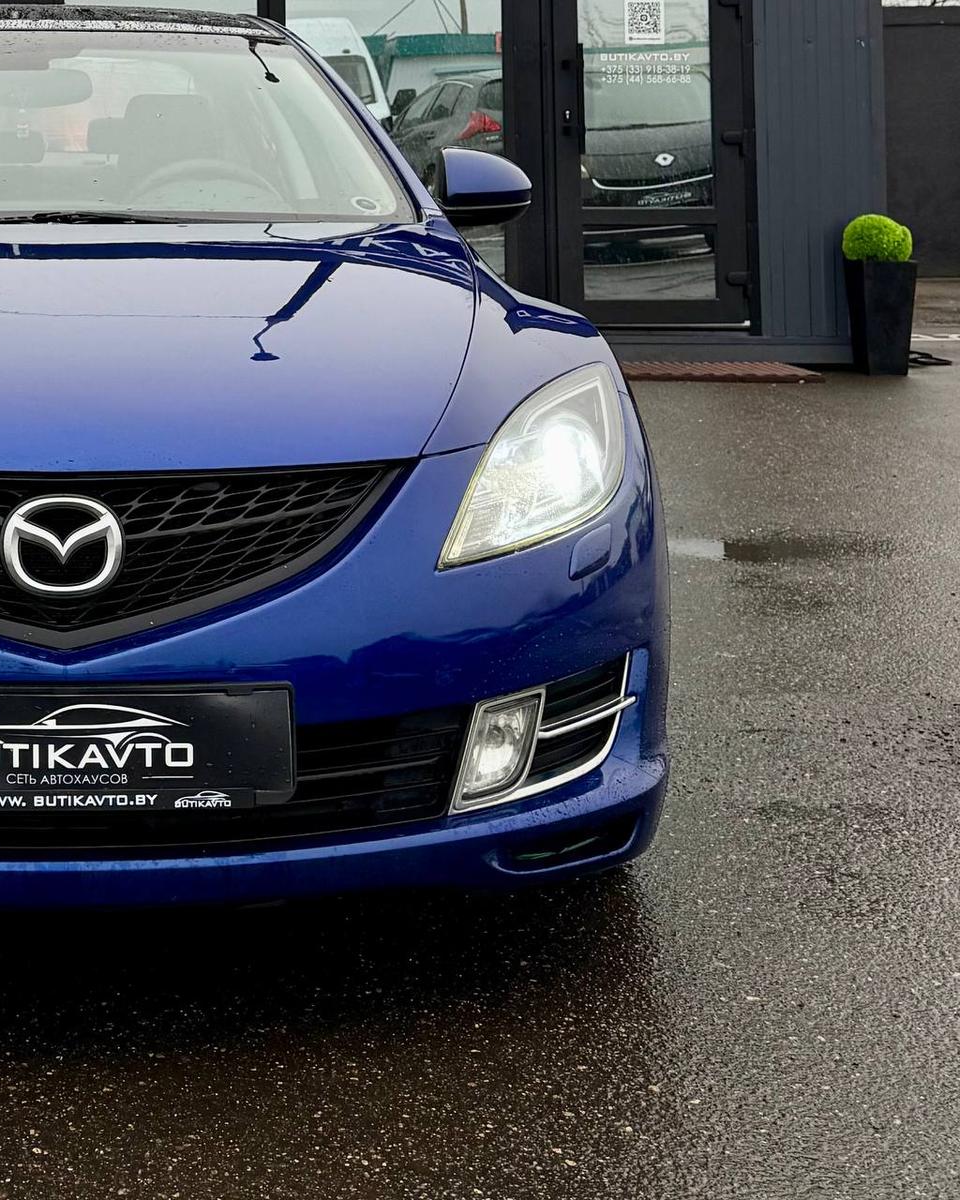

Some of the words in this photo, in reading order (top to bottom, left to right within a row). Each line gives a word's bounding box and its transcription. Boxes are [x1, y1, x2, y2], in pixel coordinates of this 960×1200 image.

[600, 53, 690, 61] BUTIKAVTO.BY
[601, 65, 623, 74] +375
[625, 65, 643, 76] (33)
[646, 64, 691, 74] 918-38-19
[601, 74, 623, 84] +375
[625, 74, 643, 85] (44)
[646, 74, 692, 84] 568-66-88
[6, 773, 37, 785] СЕТЬ
[40, 773, 128, 785] АВТОХАУСОВ
[33, 794, 158, 807] BUTIKAVTO.BY
[174, 799, 232, 809] BUTIKAVTO
